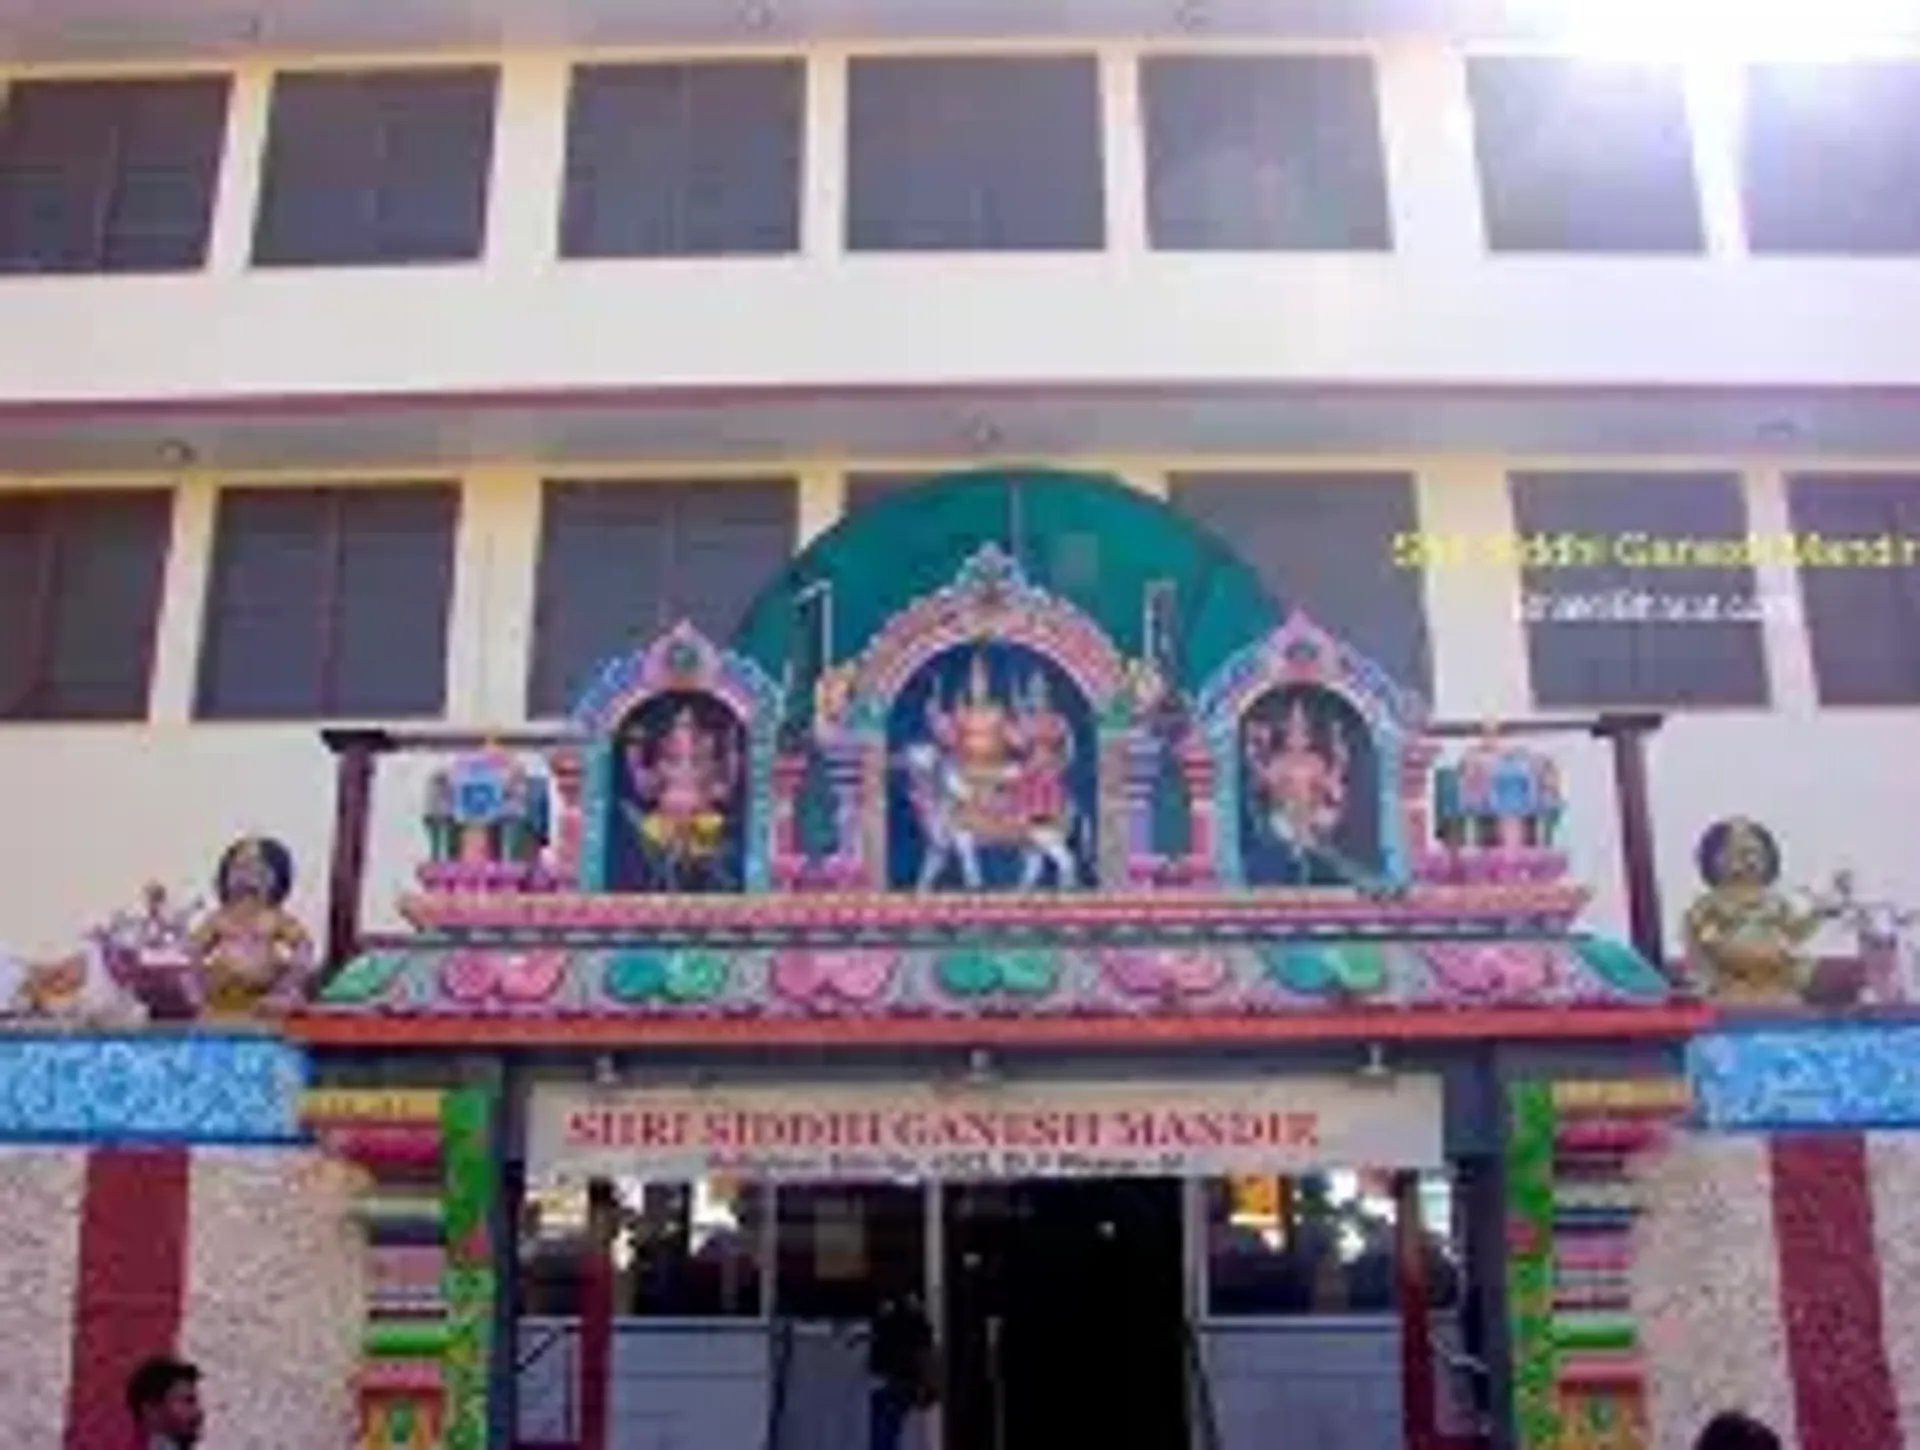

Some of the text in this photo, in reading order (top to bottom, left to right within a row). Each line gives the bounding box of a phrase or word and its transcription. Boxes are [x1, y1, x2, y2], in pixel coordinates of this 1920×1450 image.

[567, 1109, 1319, 1146] SHRI SIDDHI GANESH MANDIR
